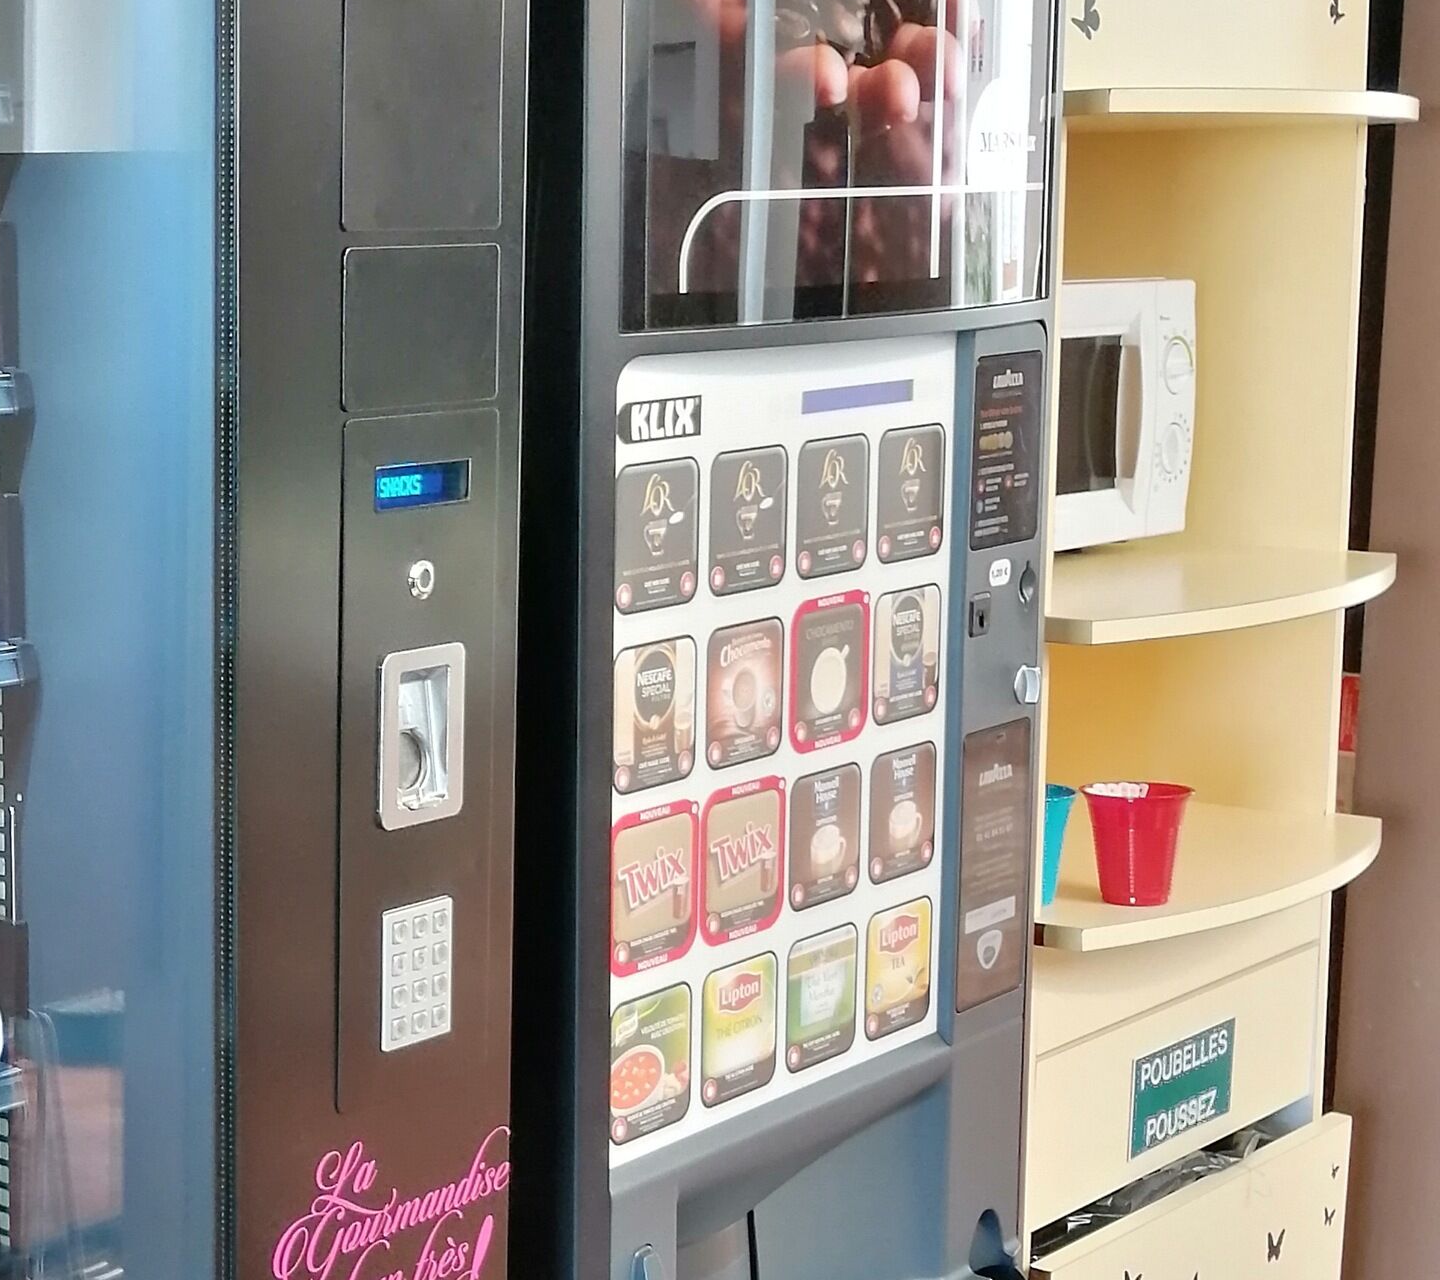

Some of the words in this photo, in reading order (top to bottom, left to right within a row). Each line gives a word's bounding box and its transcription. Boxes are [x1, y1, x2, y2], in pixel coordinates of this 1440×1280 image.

[630, 397, 696, 442] KLIX
[379, 473, 423, 498] SNACKS
[882, 923, 918, 950] Lipton
[721, 981, 760, 1007] Lipton
[1140, 1028, 1229, 1091] POUBELLES
[1145, 1088, 1218, 1147] POUSSEZ
[311, 1140, 396, 1215] La
